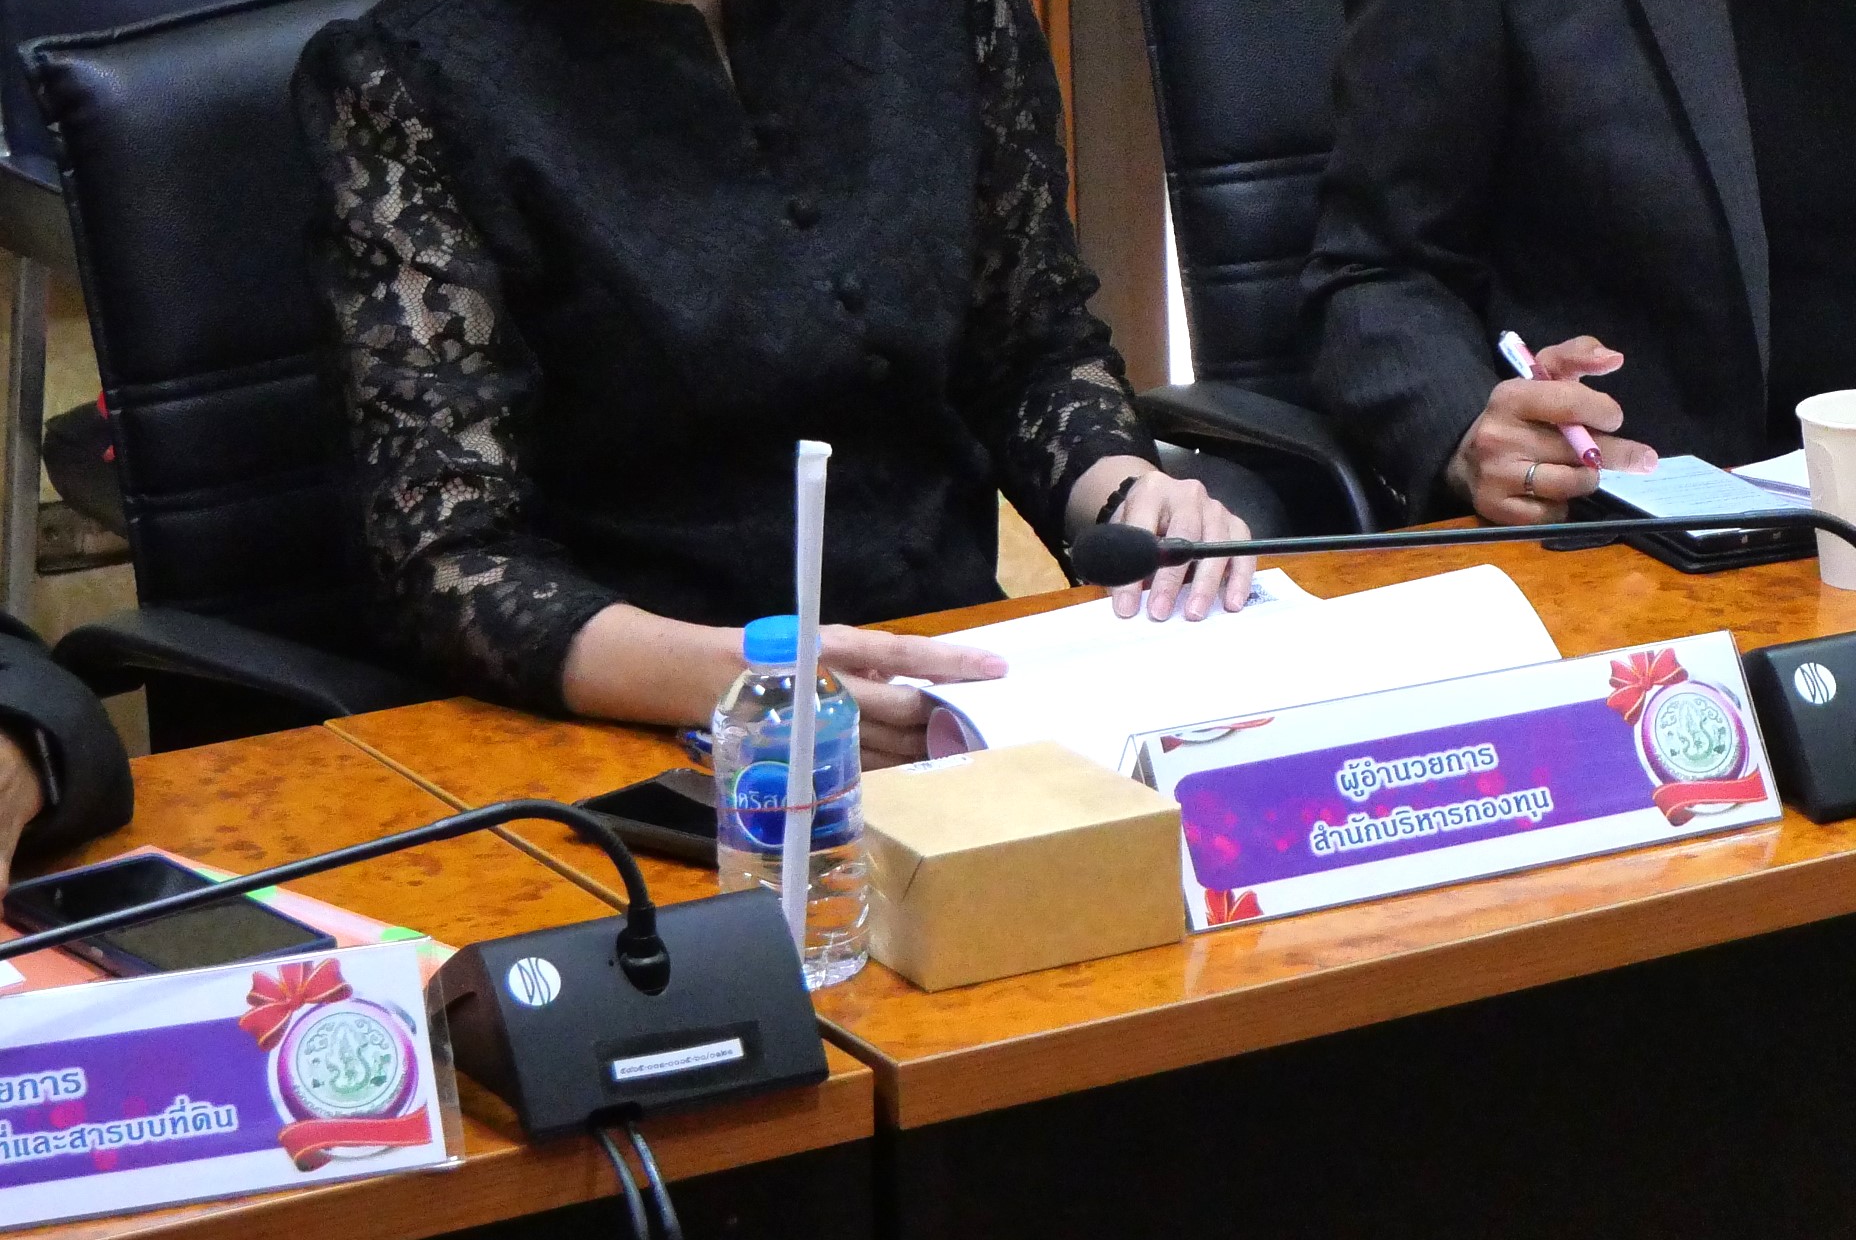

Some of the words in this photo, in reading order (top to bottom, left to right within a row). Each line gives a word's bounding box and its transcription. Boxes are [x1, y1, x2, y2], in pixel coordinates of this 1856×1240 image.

[1340, 746, 1496, 798] ผู้อำนวยการ
[738, 789, 789, 811] คริส
[1313, 789, 1551, 852] สำนักบริหารกองทุน
